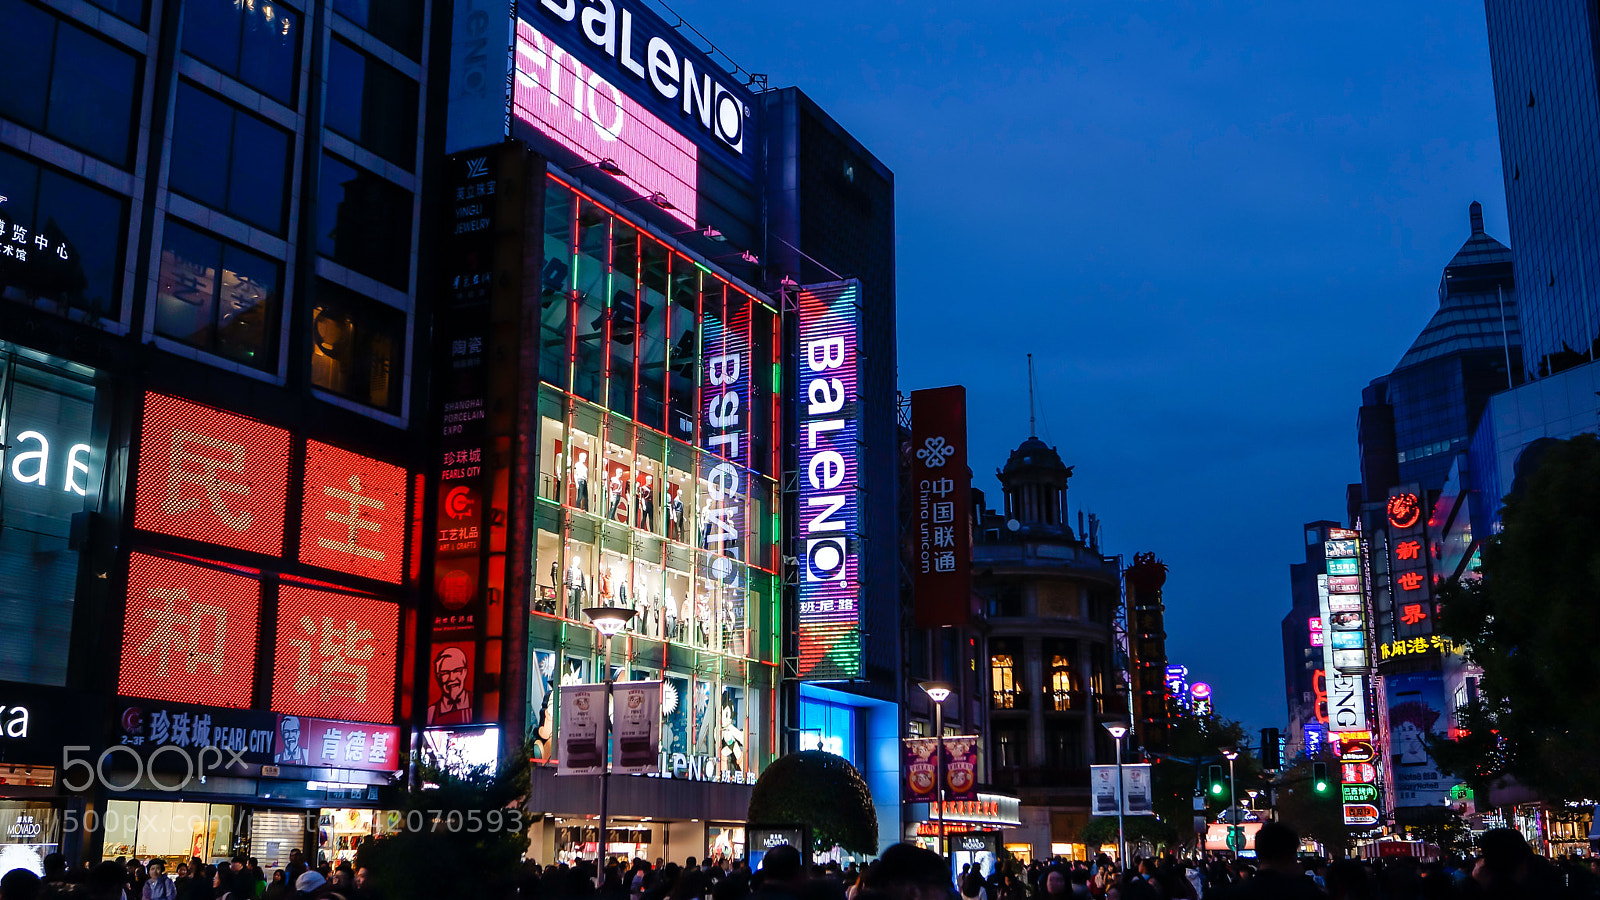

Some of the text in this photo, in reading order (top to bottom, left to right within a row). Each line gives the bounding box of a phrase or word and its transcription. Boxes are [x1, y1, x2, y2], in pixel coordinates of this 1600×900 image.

[0, 242, 27, 262] 术馆
[444, 397, 483, 413] SHANGHAI
[444, 410, 485, 424] PORCELAIN
[443, 424, 463, 437] EXPO
[443, 447, 481, 466] 珍珠城
[441, 466, 481, 480] PEARLS CITY
[932, 476, 956, 573] 中国联通
[438, 526, 479, 541] 工艺礼品
[1395, 540, 1427, 625] 新世界
[799, 600, 855, 614] 班尼路
[120, 734, 145, 746] 2-3F
[149, 710, 274, 755] 珍珠城 PEARL CITY
[321, 727, 390, 764] 肯德基
[7, 823, 41, 835] MOVADO
